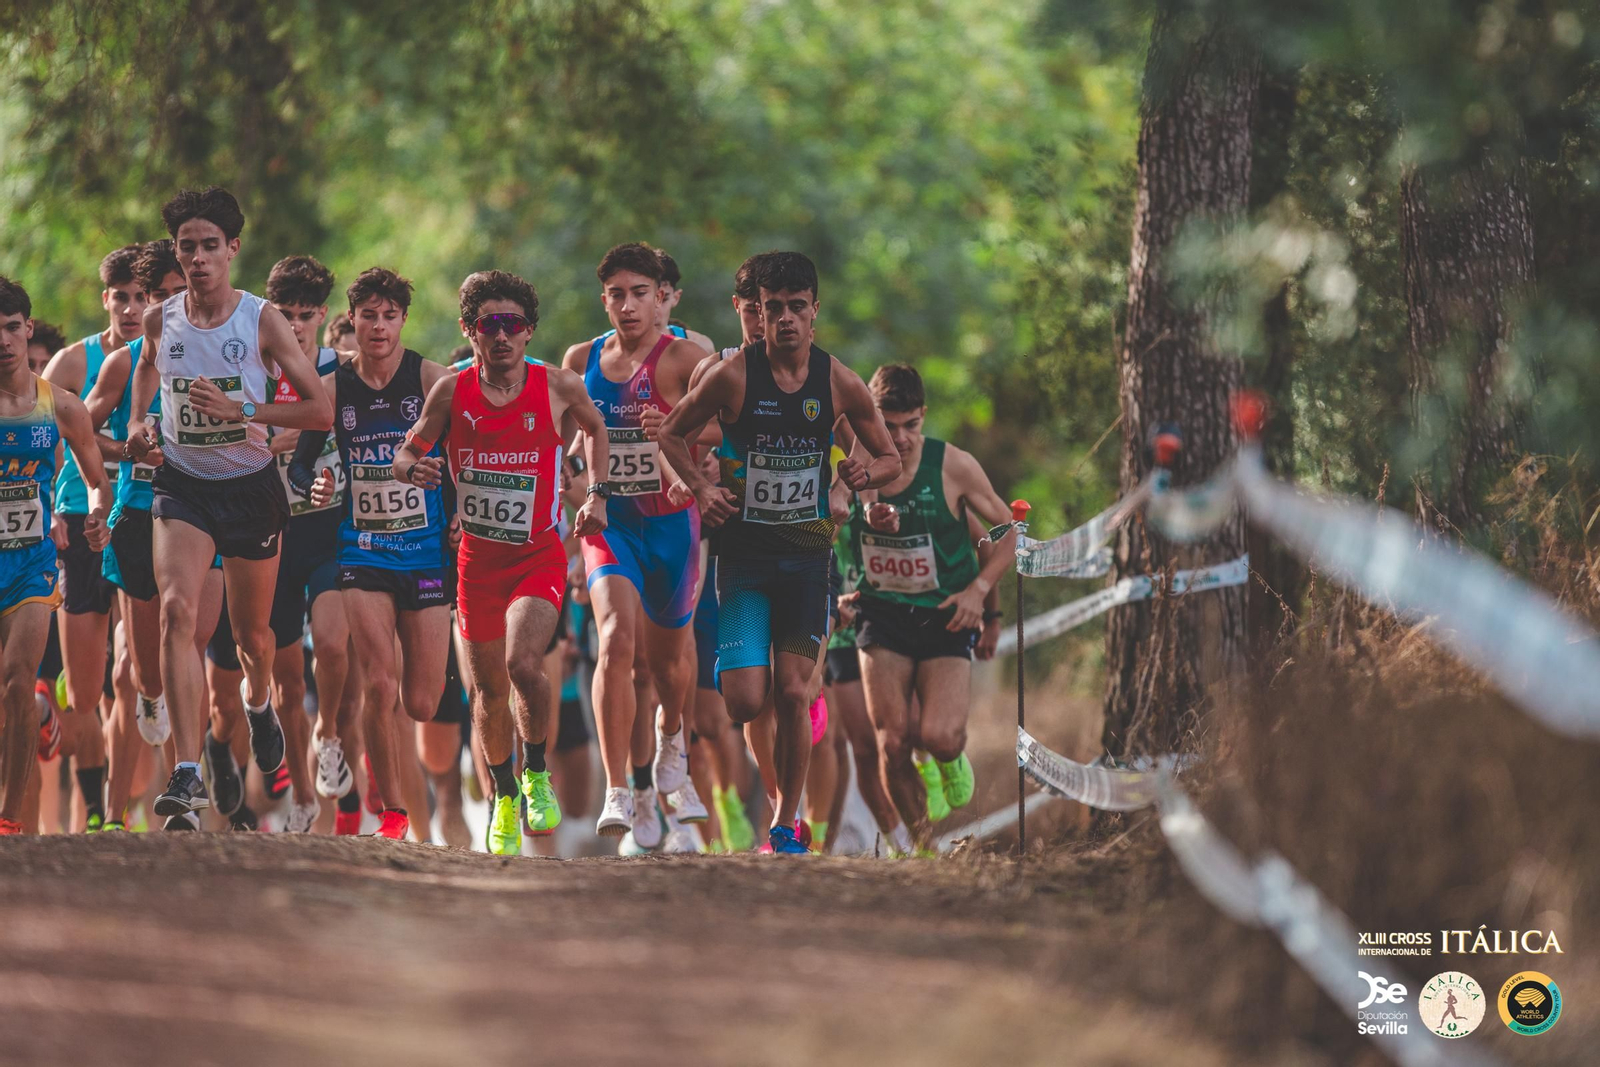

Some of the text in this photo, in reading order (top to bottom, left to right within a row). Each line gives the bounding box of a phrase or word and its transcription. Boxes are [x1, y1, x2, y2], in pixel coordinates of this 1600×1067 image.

[370, 402, 390, 410] amura
[756, 434, 817, 449] PLAYAS
[478, 451, 540, 464] navarra
[771, 457, 806, 467] ITÁLICA
[478, 473, 515, 485] ITÁLICA
[754, 478, 814, 504] 6124
[358, 488, 420, 514] 6156
[463, 495, 527, 525] 6162
[374, 534, 404, 543] XUNTA
[387, 543, 422, 551] GALICIA
[869, 555, 930, 577] 6405
